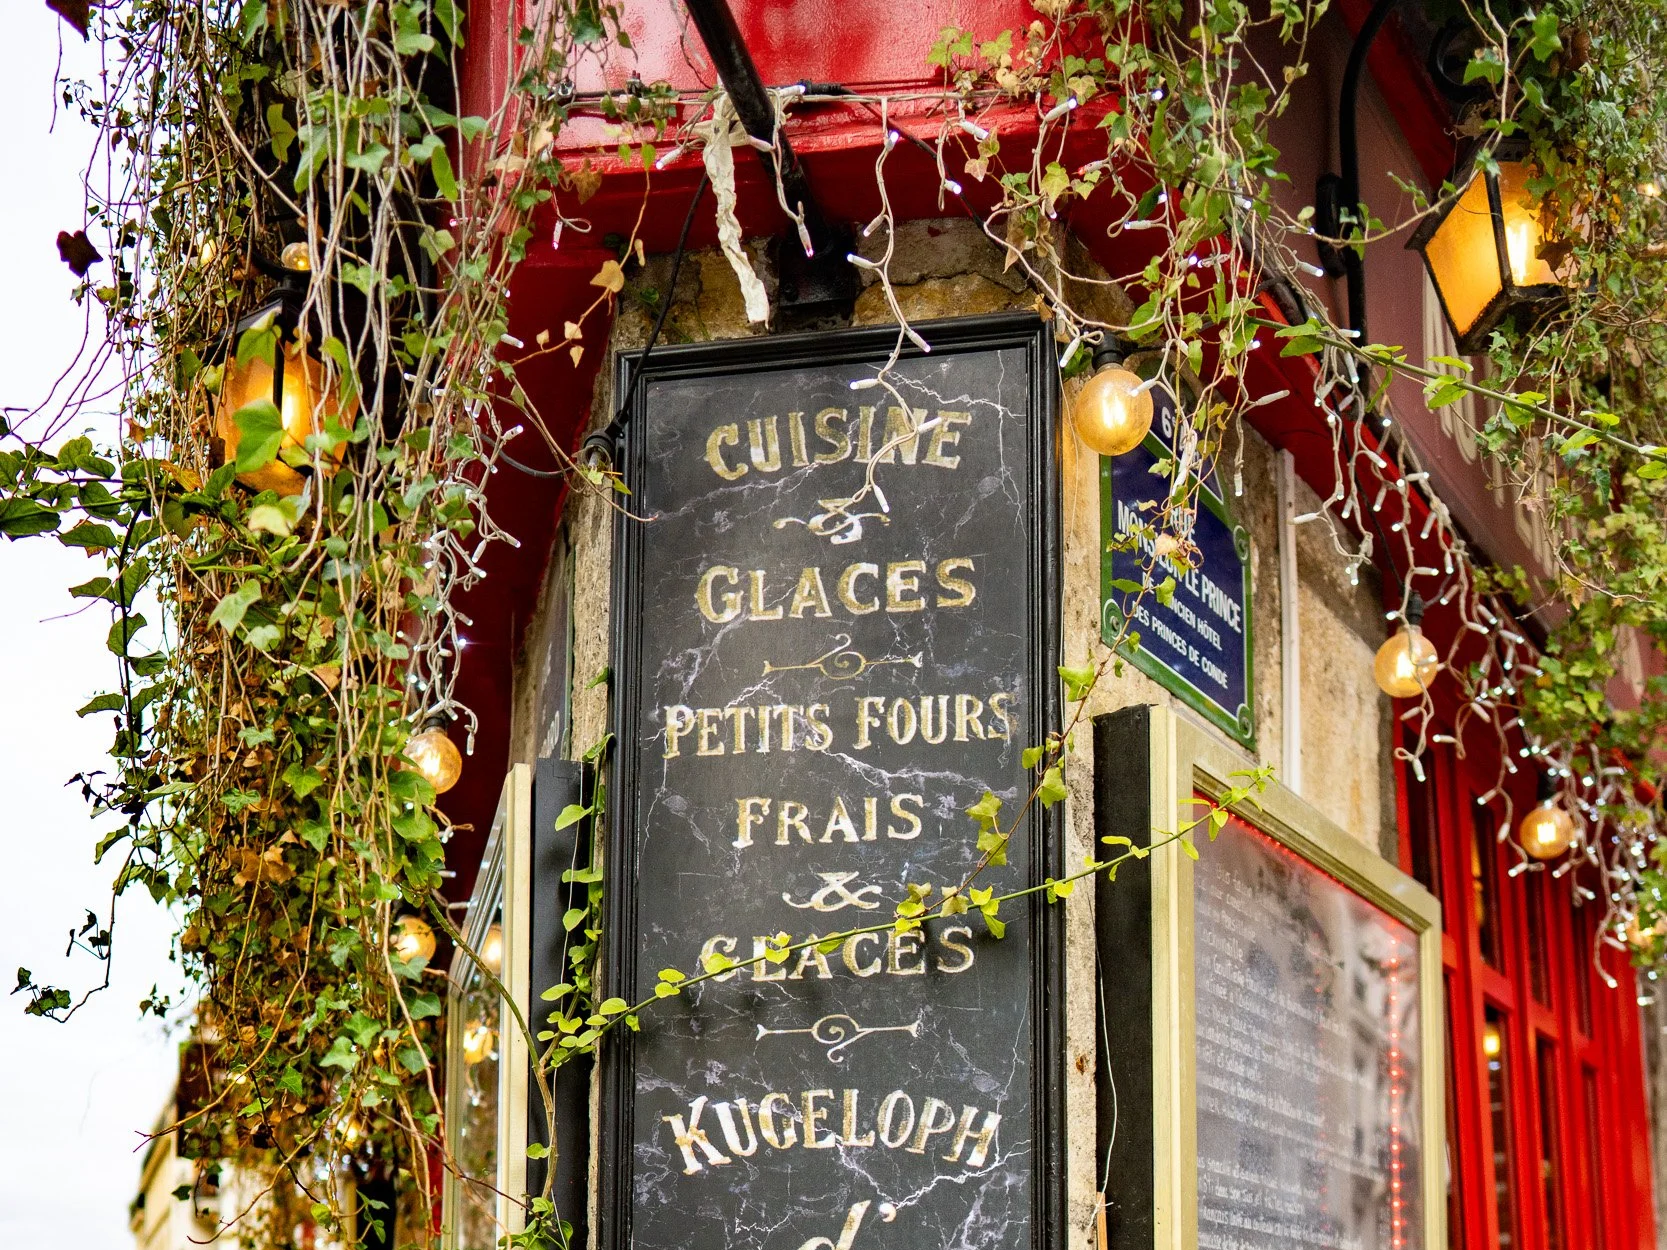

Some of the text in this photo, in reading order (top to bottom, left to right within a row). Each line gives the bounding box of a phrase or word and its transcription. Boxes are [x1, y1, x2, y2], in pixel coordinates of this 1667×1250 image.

[704, 405, 972, 481] CUISINE
[695, 557, 976, 624] GLACES
[1185, 562, 1200, 598] LE
[1202, 574, 1241, 633] PRINCE
[1132, 601, 1228, 689] DES PRINCES DE CONDÉ
[1197, 618, 1222, 651] HÔTEL
[662, 692, 1015, 760] PETITS FOURS
[733, 794, 925, 850] FRAIS
[782, 872, 884, 912] &
[700, 926, 975, 983] GLACES
[662, 1089, 1002, 1176] KUGELOPH
